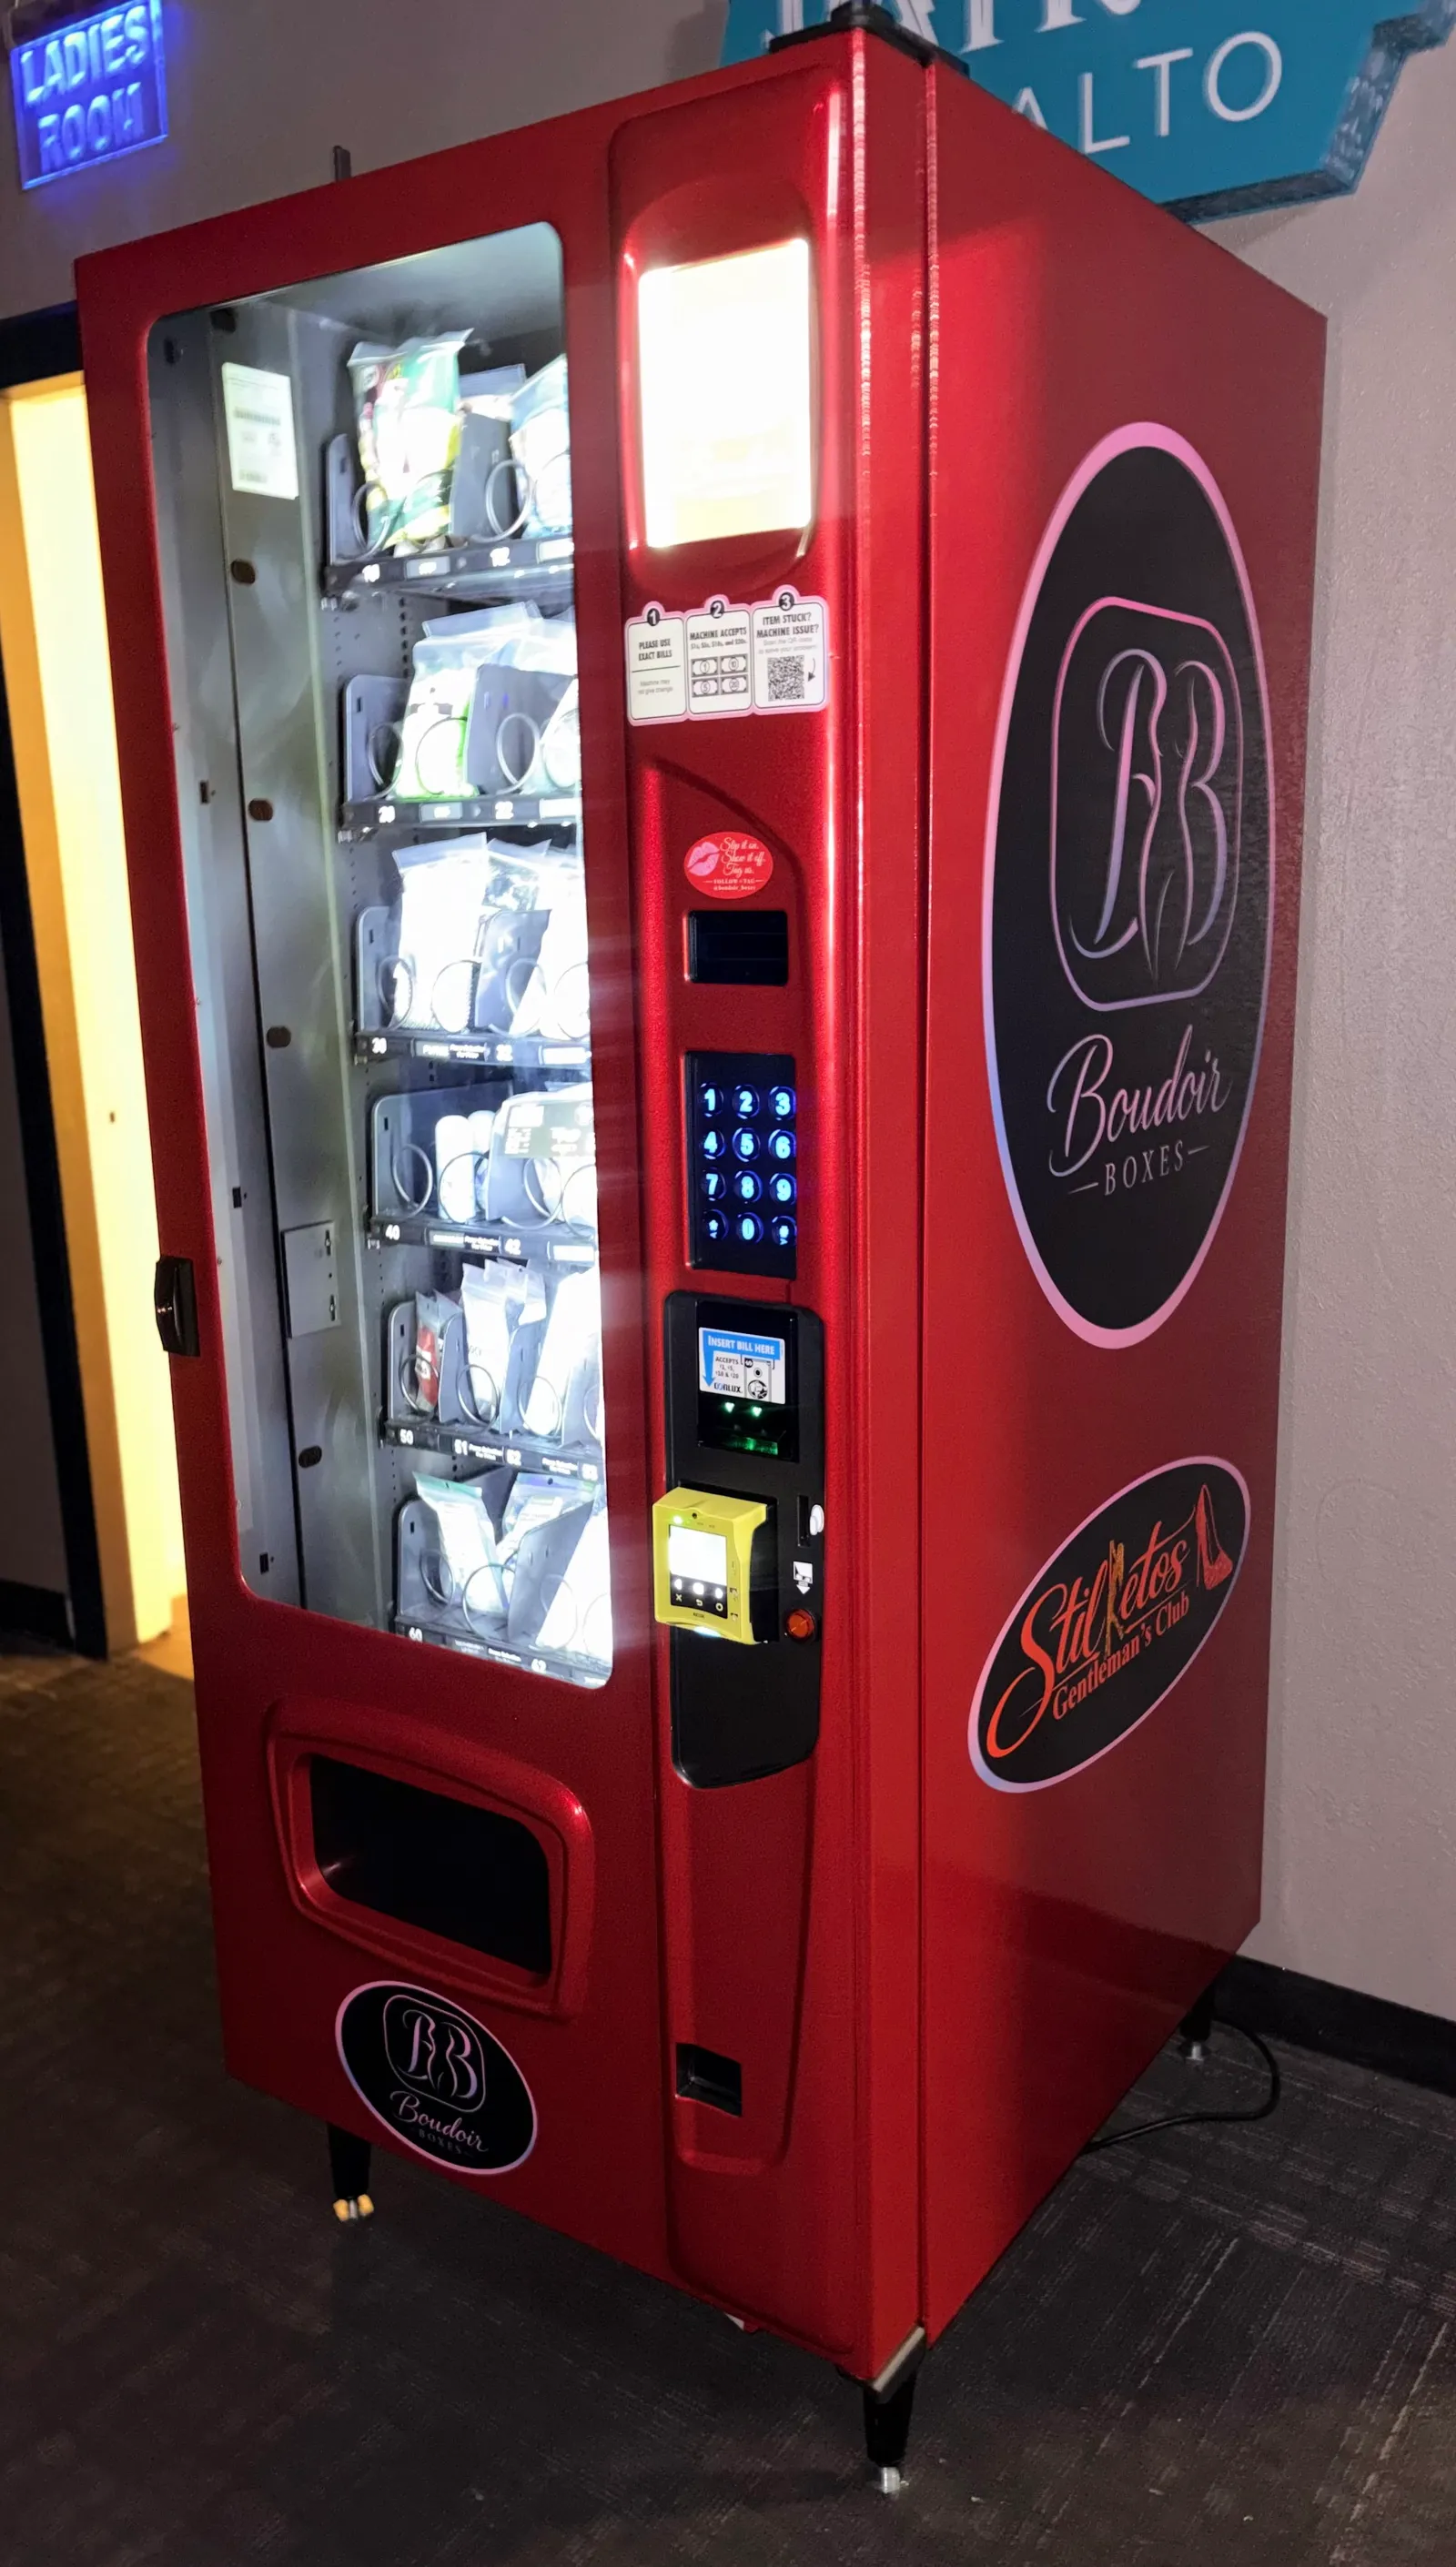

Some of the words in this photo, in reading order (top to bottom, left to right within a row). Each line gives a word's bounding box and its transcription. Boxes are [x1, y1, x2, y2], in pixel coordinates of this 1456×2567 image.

[21, 5, 148, 106] LADIES
[38, 82, 144, 172] ROOM
[713, 601, 723, 617] 2
[782, 593, 792, 610] 3
[649, 610, 657, 625] 1
[763, 615, 781, 626] ITEM
[782, 611, 812, 623] STUCK?
[690, 630, 718, 641] MACHINE
[720, 626, 747, 637] ACCEPTS
[756, 626, 790, 638] MACHINE
[792, 624, 819, 635] ISSUE?
[639, 640, 658, 650] PLEASE
[660, 638, 671, 647] USE
[638, 652, 655, 661] EXACT
[656, 650, 672, 659] BILLS
[704, 1088, 716, 1111] 1
[739, 1091, 753, 1112] 2
[775, 1092, 791, 1116] 3
[1046, 1024, 1233, 1177] Boudoir
[703, 1131, 718, 1154] 4
[740, 1133, 754, 1156] 5
[775, 1136, 791, 1159] 6
[1104, 1139, 1184, 1196] BOXES
[705, 1173, 719, 1196] 7
[741, 1176, 754, 1198] 8
[776, 1178, 792, 1201] 9
[385, 1224, 400, 1240] 40
[742, 1218, 755, 1240] 0
[707, 1335, 735, 1349] INSERT
[736, 1340, 753, 1352] BILL
[754, 1343, 775, 1355] HERE
[715, 1356, 739, 1365] ACCEPTS
[1052, 1622, 1152, 1721] Gentleman's
[1155, 1592, 1190, 1637] Club
[389, 2090, 489, 2153] Boudoir
